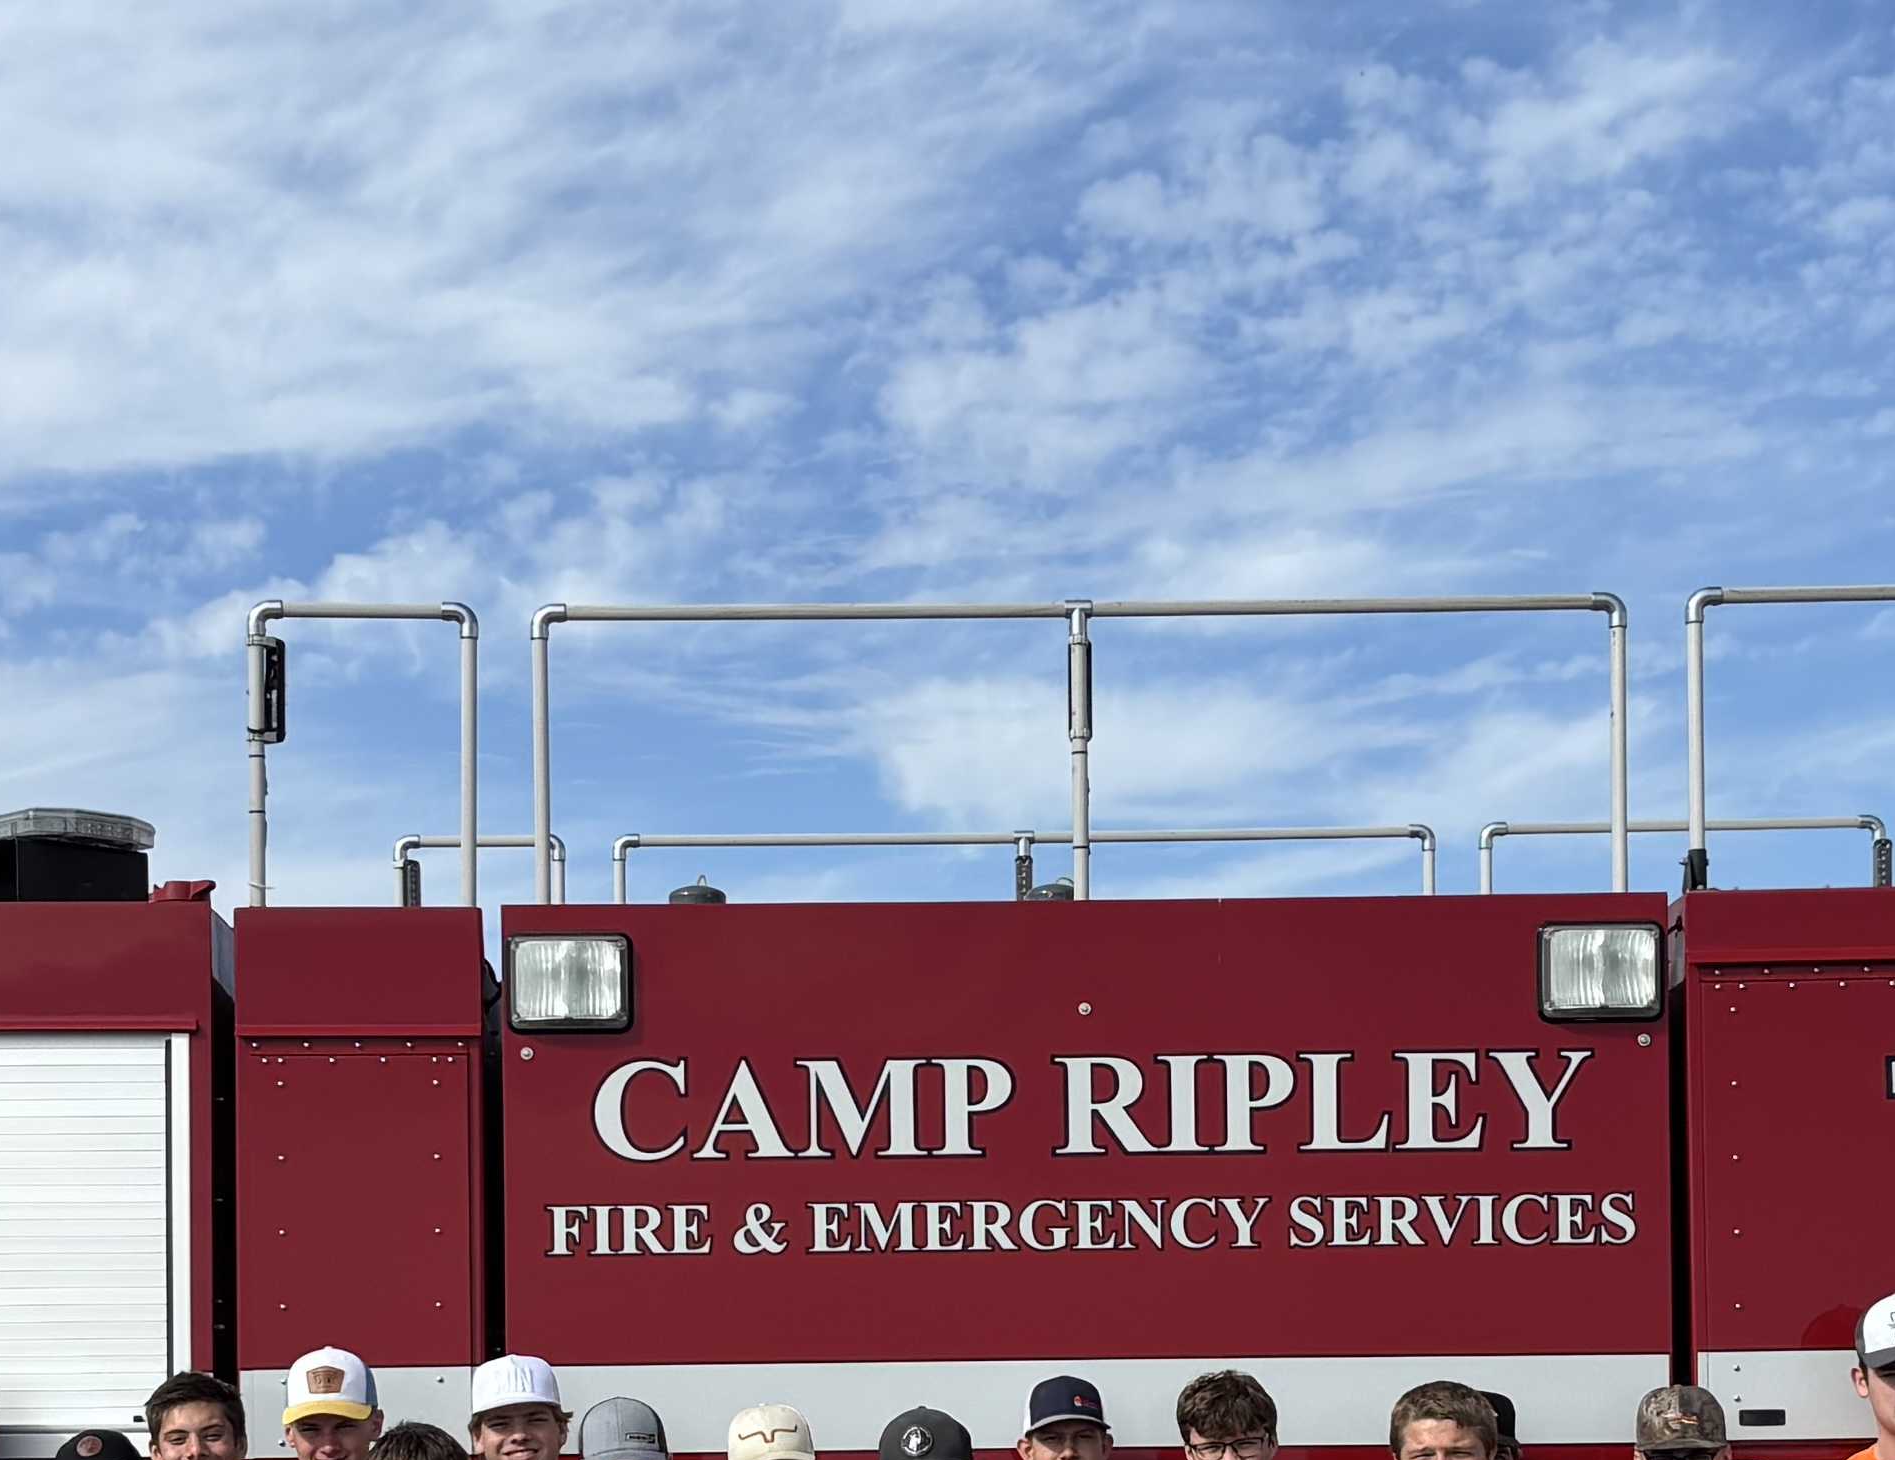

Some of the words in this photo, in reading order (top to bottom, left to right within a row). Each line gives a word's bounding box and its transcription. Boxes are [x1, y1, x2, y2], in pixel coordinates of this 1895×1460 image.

[591, 1056, 1016, 1162] CAMP
[1052, 1048, 1595, 1155] RIPLEY
[545, 1203, 712, 1256] FIRE
[731, 1201, 790, 1256] &
[807, 1196, 1270, 1254] EMERGENCY
[1288, 1191, 1637, 1248] SERVICES
